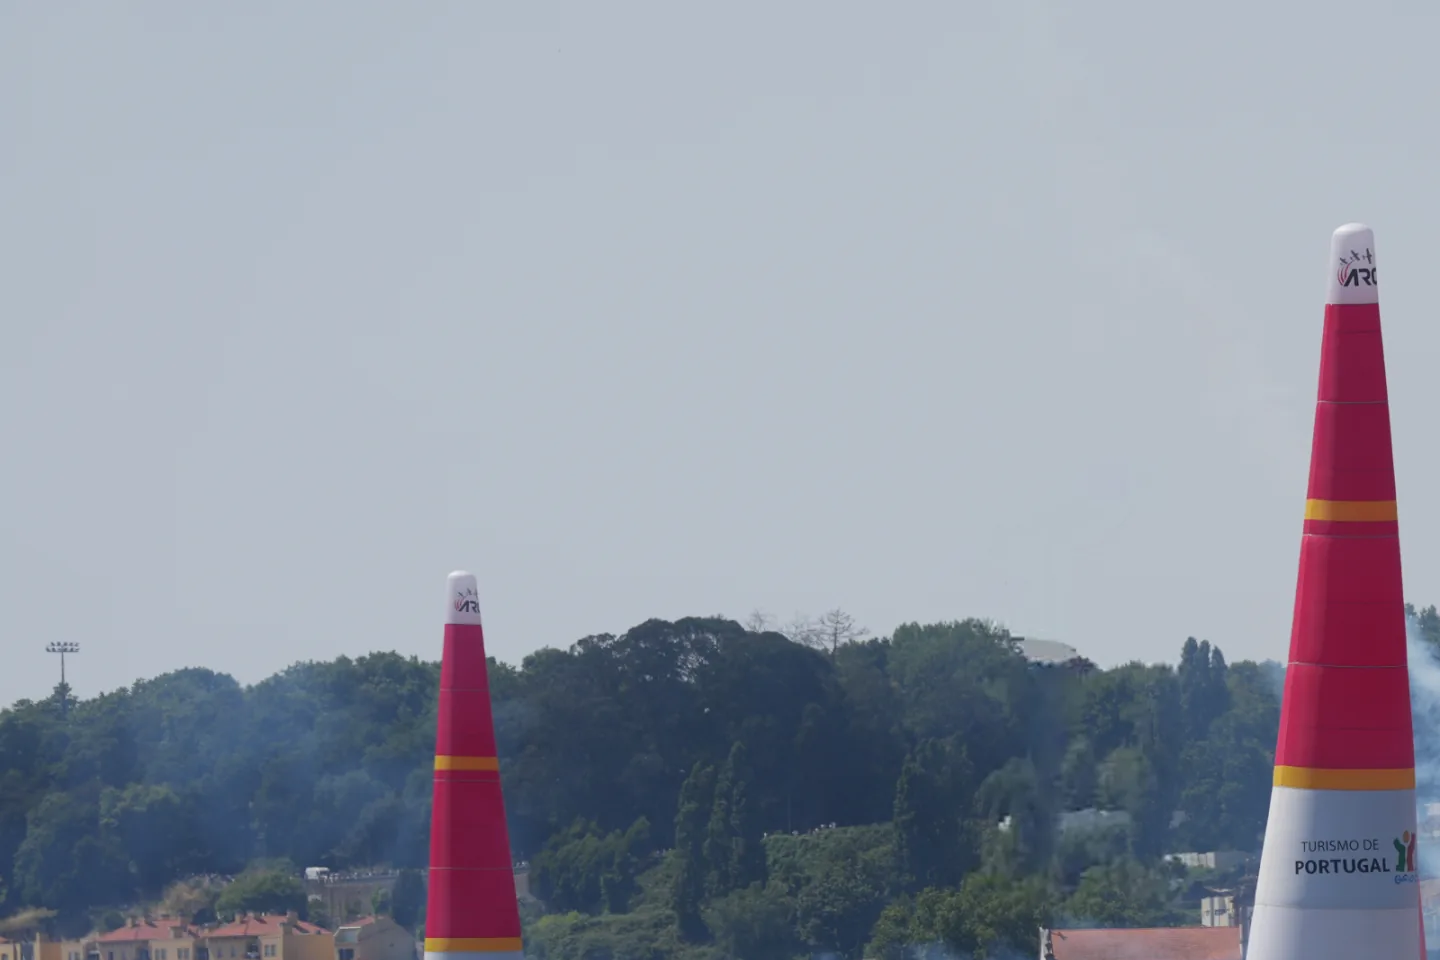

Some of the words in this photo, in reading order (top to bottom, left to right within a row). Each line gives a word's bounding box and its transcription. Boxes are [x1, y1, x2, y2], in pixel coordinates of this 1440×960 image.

[459, 600, 480, 613] AR
[1301, 839, 1359, 852] TURISMO
[1363, 839, 1379, 850] DE
[1295, 858, 1390, 875] PORTUGAL
